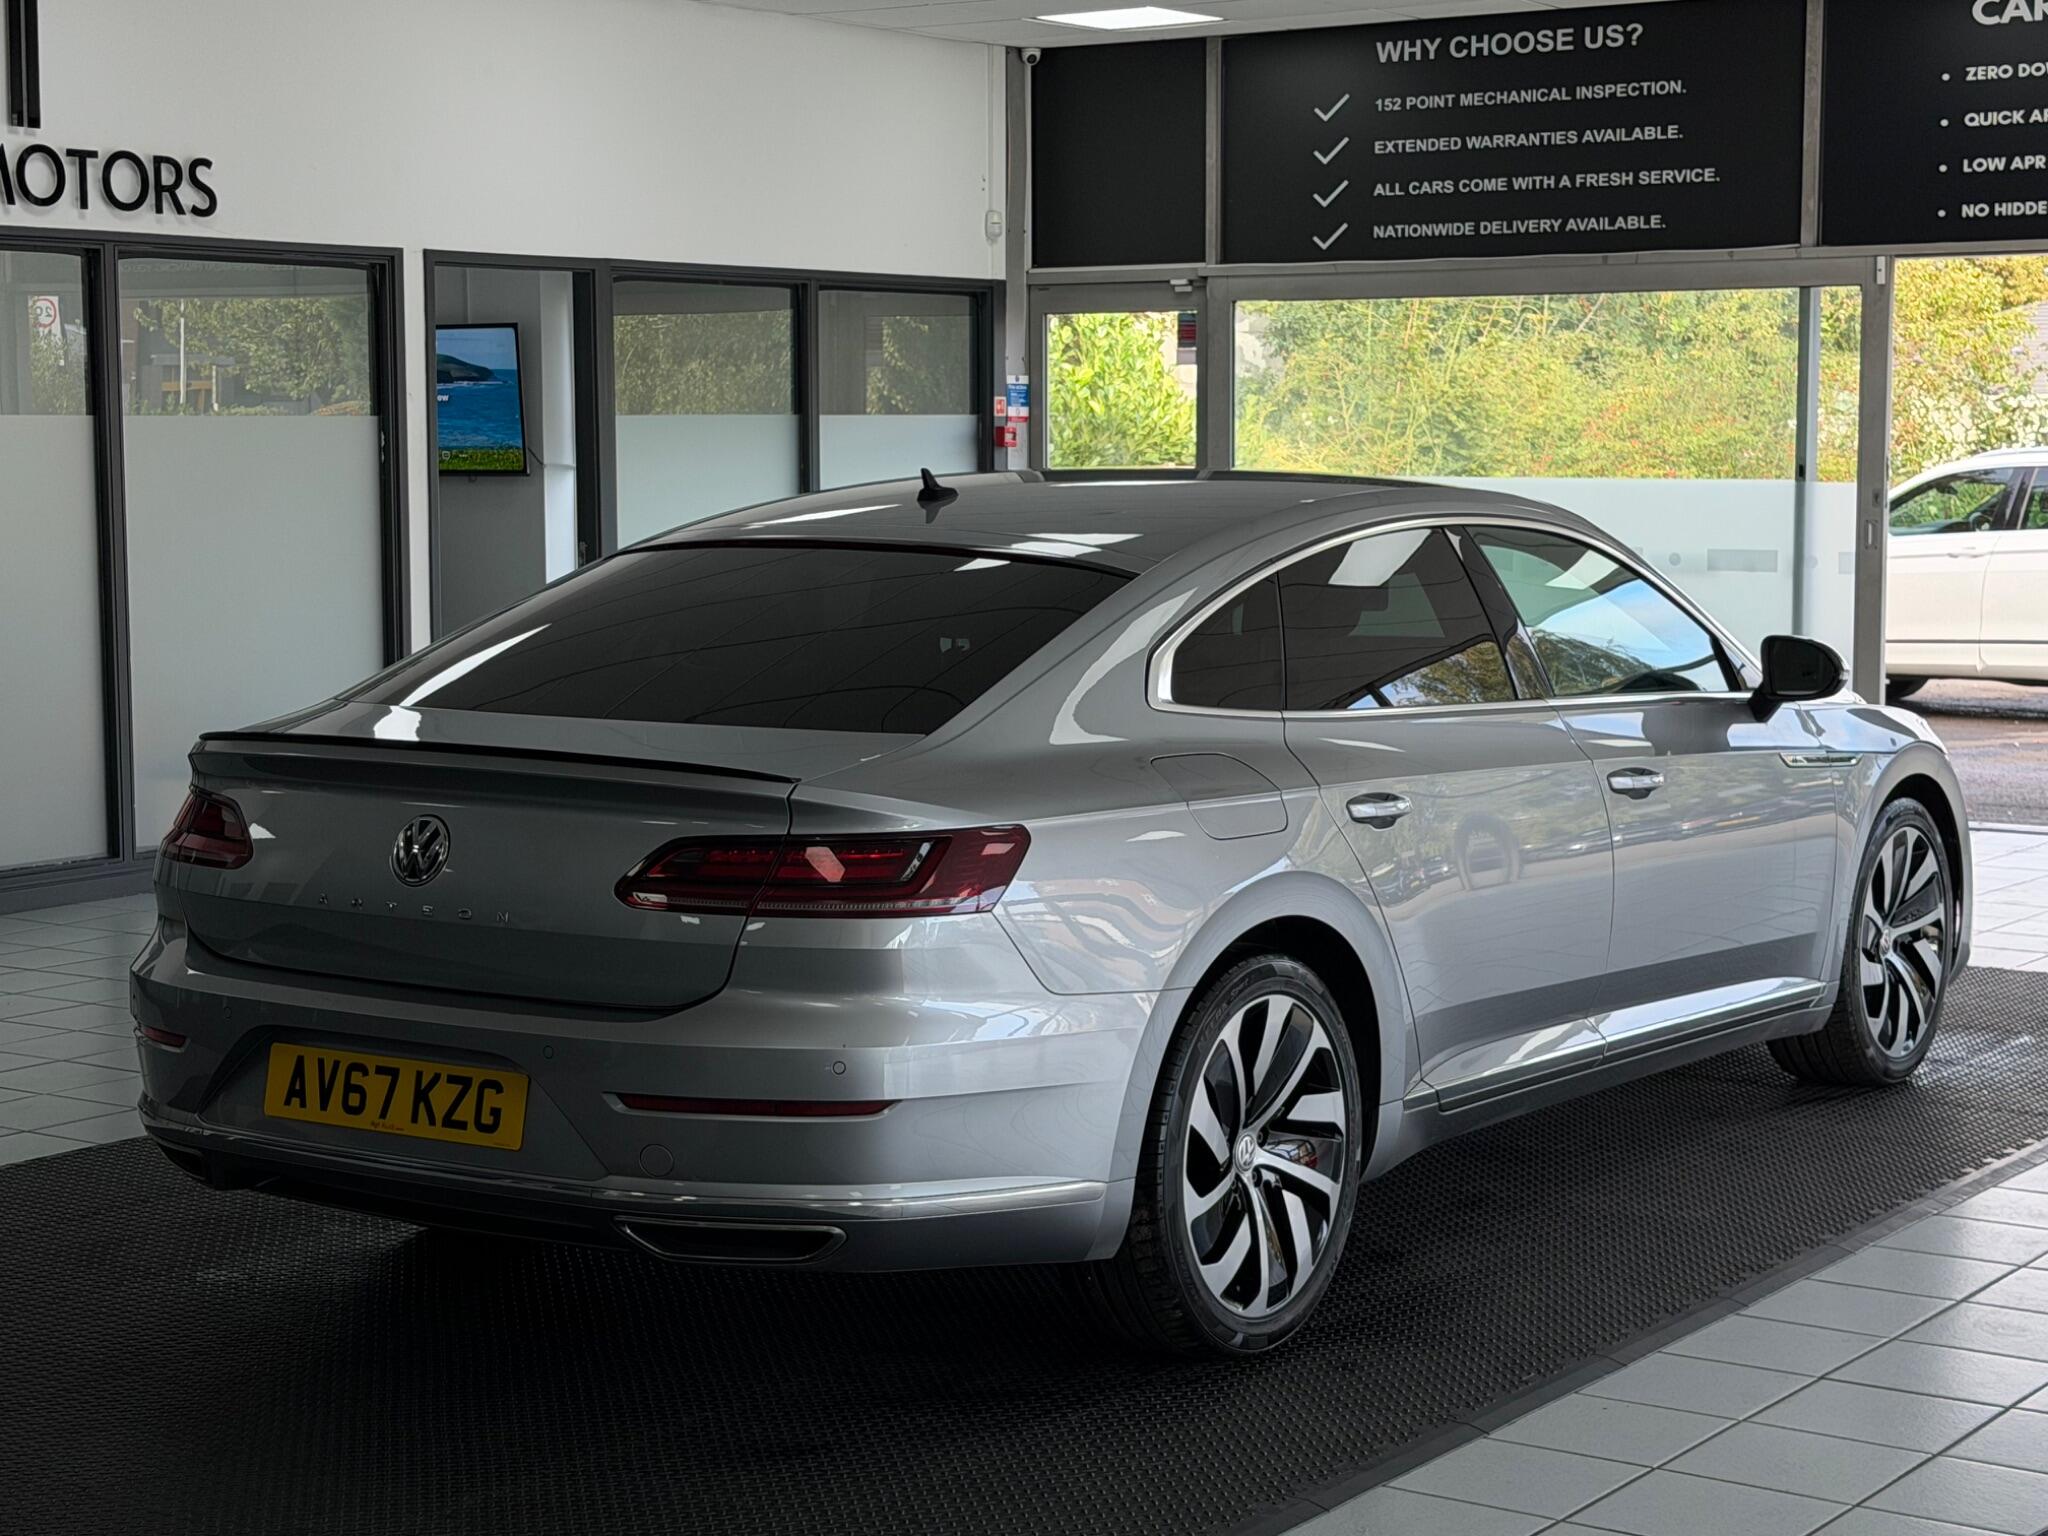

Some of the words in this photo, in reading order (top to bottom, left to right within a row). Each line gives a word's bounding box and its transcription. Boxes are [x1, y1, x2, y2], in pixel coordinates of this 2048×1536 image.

[1376, 38, 1442, 64] WHY
[1449, 28, 1574, 58] CHOOSE
[1584, 23, 1644, 49] US?
[1965, 64, 2014, 82] ZERO
[2018, 61, 2048, 78] DO
[1375, 97, 1402, 112] 152
[1406, 94, 1456, 110] POINT
[1459, 87, 1572, 107] MECHANICAL
[1576, 79, 1687, 100] INSPECTION.
[1963, 109, 2026, 127] QUICK
[1374, 136, 1462, 154] EXTENDED
[1465, 130, 1578, 149] WARRANTIES
[1582, 125, 1683, 144] AVAILABLE.
[1962, 156, 2007, 173] LOW
[2010, 154, 2047, 171] APR
[1373, 182, 1405, 197] ALL
[1408, 179, 1455, 195] CARS
[1458, 177, 1508, 193] COME
[1512, 175, 1555, 190] WITH
[1558, 174, 1572, 188] A
[1575, 171, 1634, 188] FRESH
[1638, 167, 1720, 185] SERVICE.
[1961, 203, 1990, 218] NO
[1994, 200, 2048, 217] HIDDE
[1373, 222, 1475, 239] NATIONWIDE
[1479, 218, 1562, 235] DELIVERY
[1565, 214, 1666, 232] AVAILABLE.
[283, 1054, 401, 1121] AV67
[410, 1069, 505, 1135] KZG
